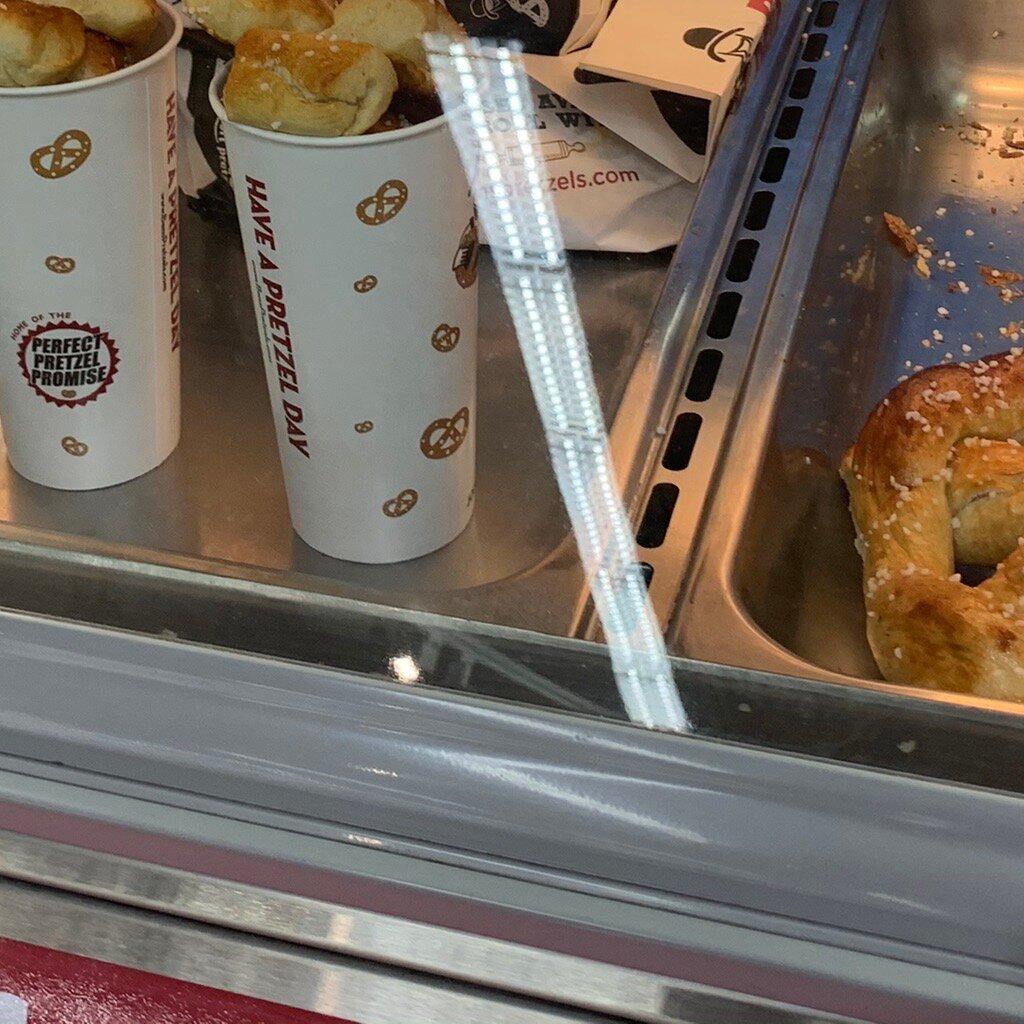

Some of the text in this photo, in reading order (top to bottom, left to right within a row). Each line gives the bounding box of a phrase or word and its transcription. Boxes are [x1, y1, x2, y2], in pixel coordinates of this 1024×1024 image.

[10, 311, 72, 340] HOME OF THE
[244, 174, 311, 460] HAVE A PRETZEL DAY
[31, 333, 103, 354] PERFECT
[33, 351, 101, 370] PRETZEL
[31, 365, 107, 387] PROMISE
